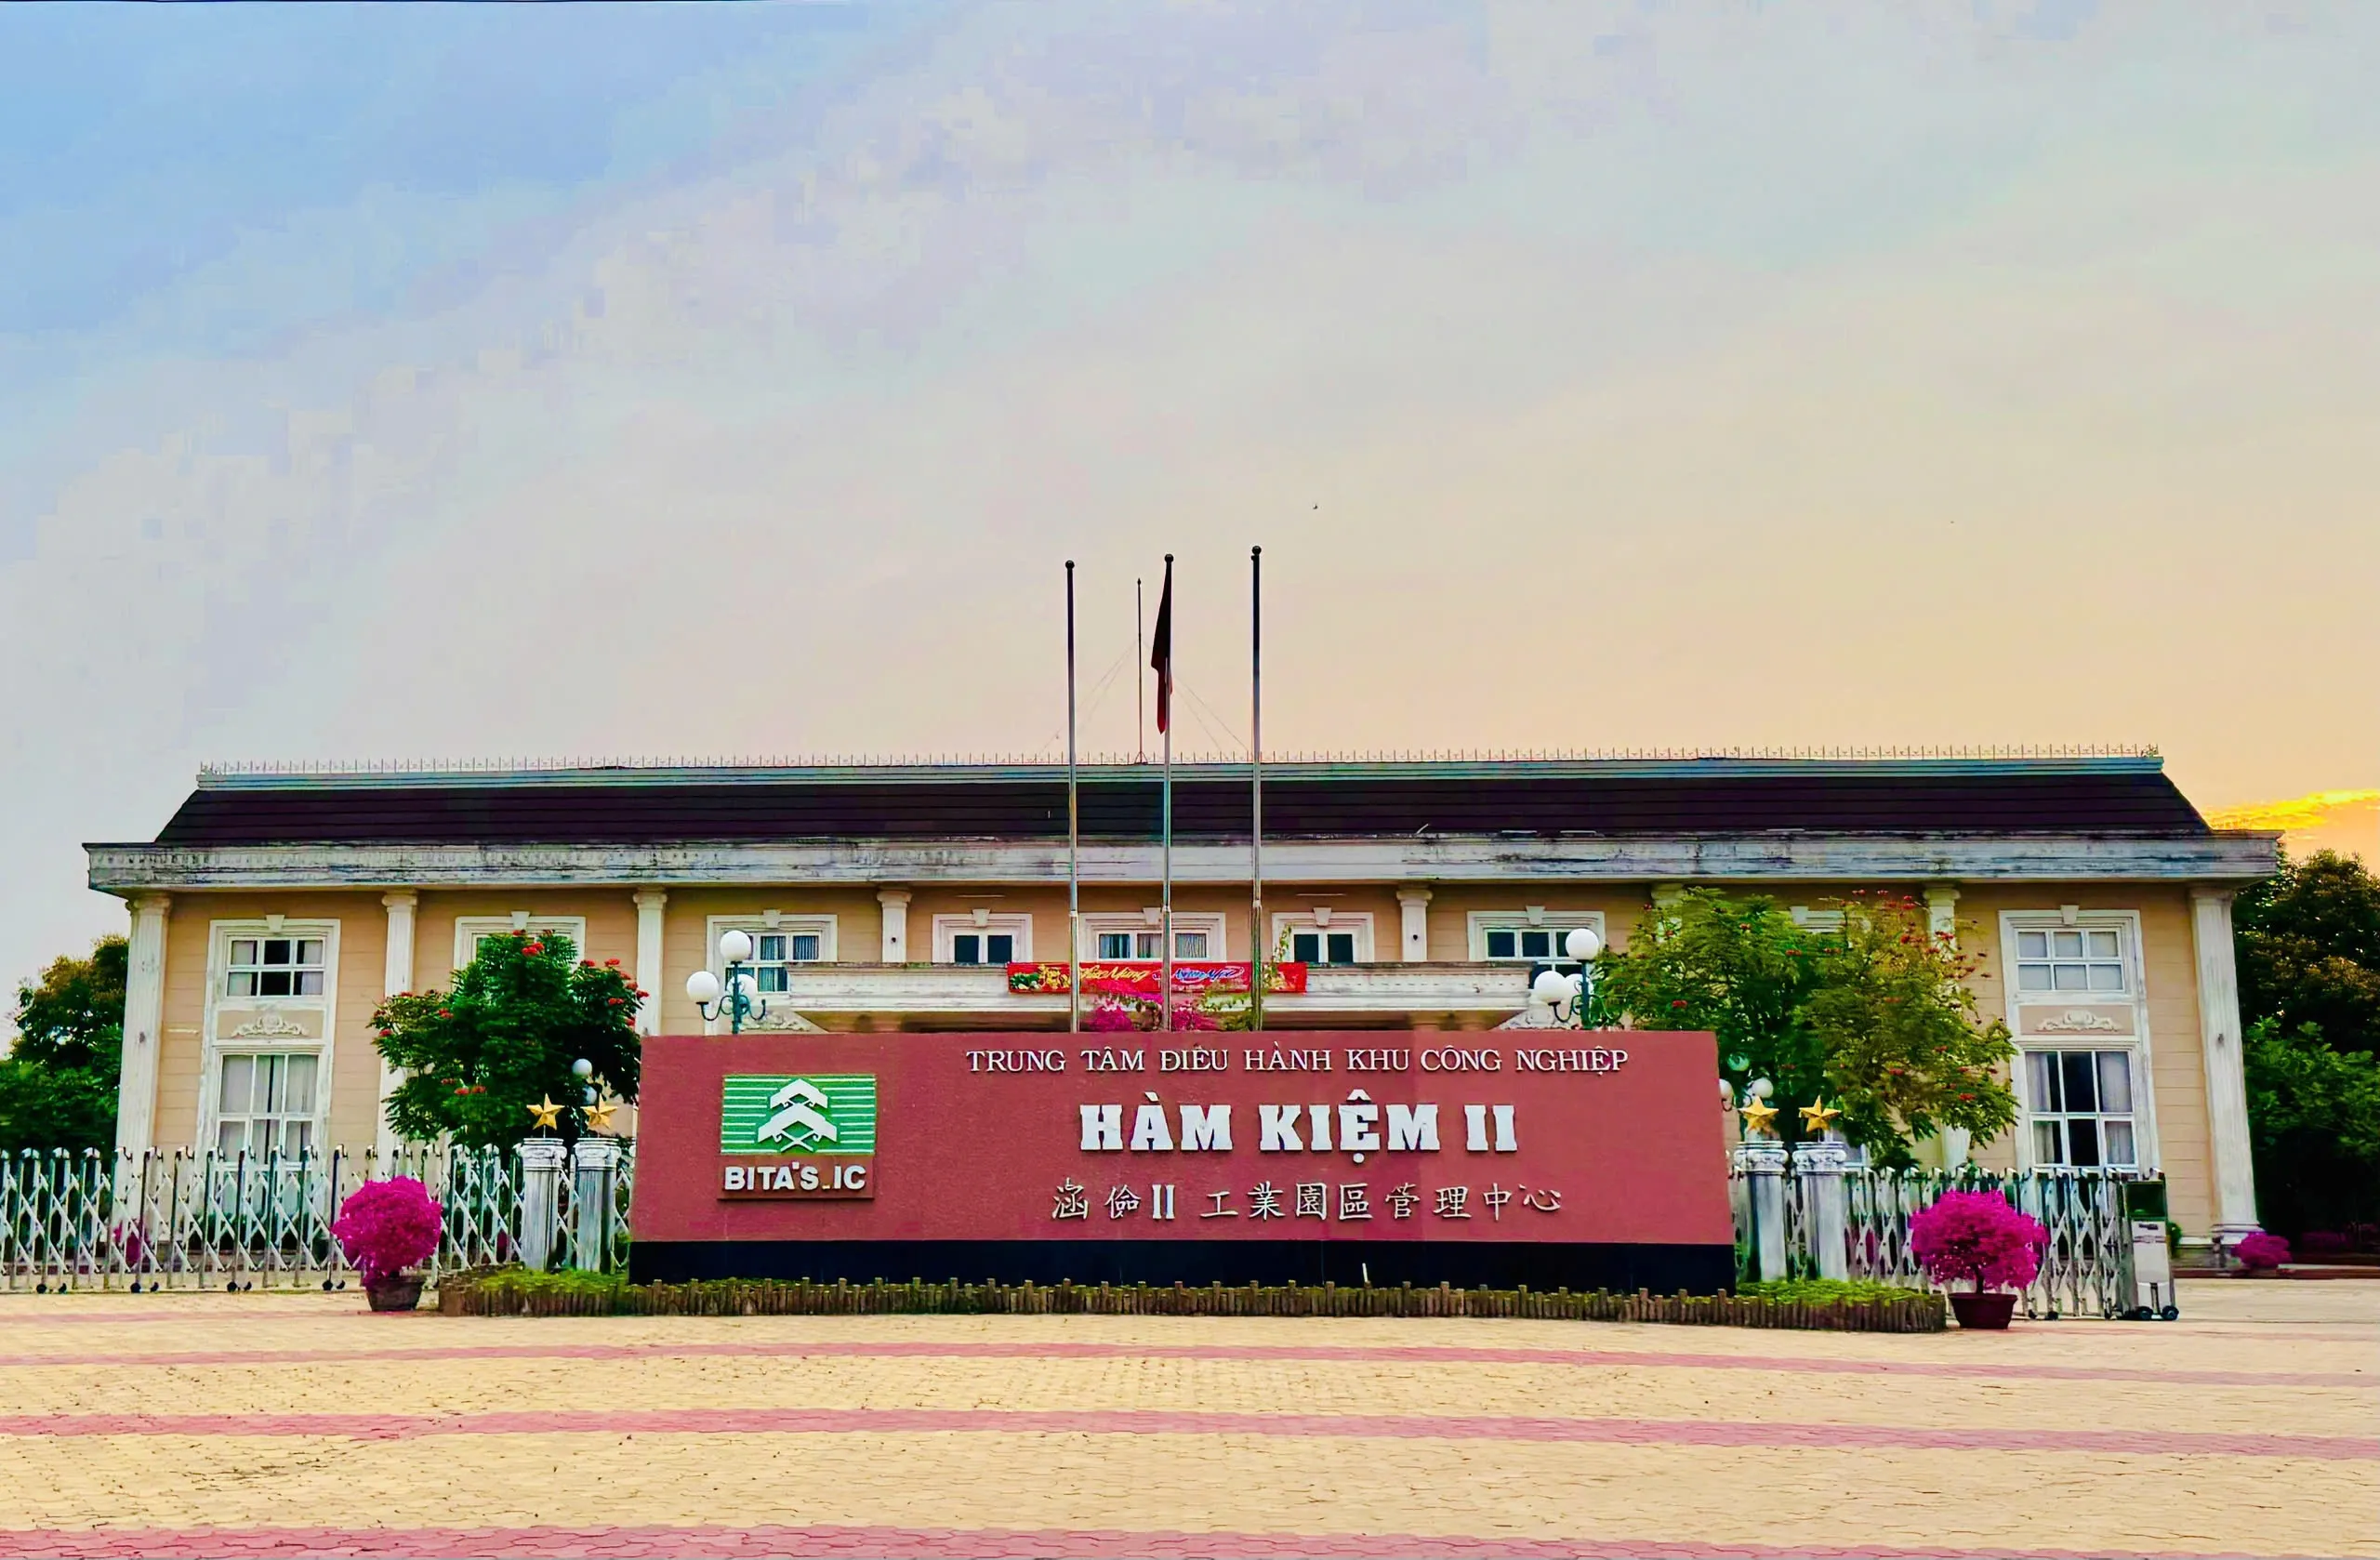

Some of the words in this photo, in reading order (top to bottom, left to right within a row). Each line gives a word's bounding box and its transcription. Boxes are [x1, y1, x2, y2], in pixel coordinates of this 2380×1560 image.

[966, 1050, 1066, 1072] TRUNG
[1080, 1046, 1145, 1071] TÂM
[1244, 1040, 1332, 1071] HÀNH
[1344, 1049, 1410, 1071] KHU
[1421, 1044, 1502, 1071] CÔNG
[1514, 1046, 1629, 1076] NGHIỆP
[1079, 1091, 1234, 1152] HÀM
[1258, 1089, 1441, 1163] KIỆM
[1463, 1104, 1518, 1152] II
